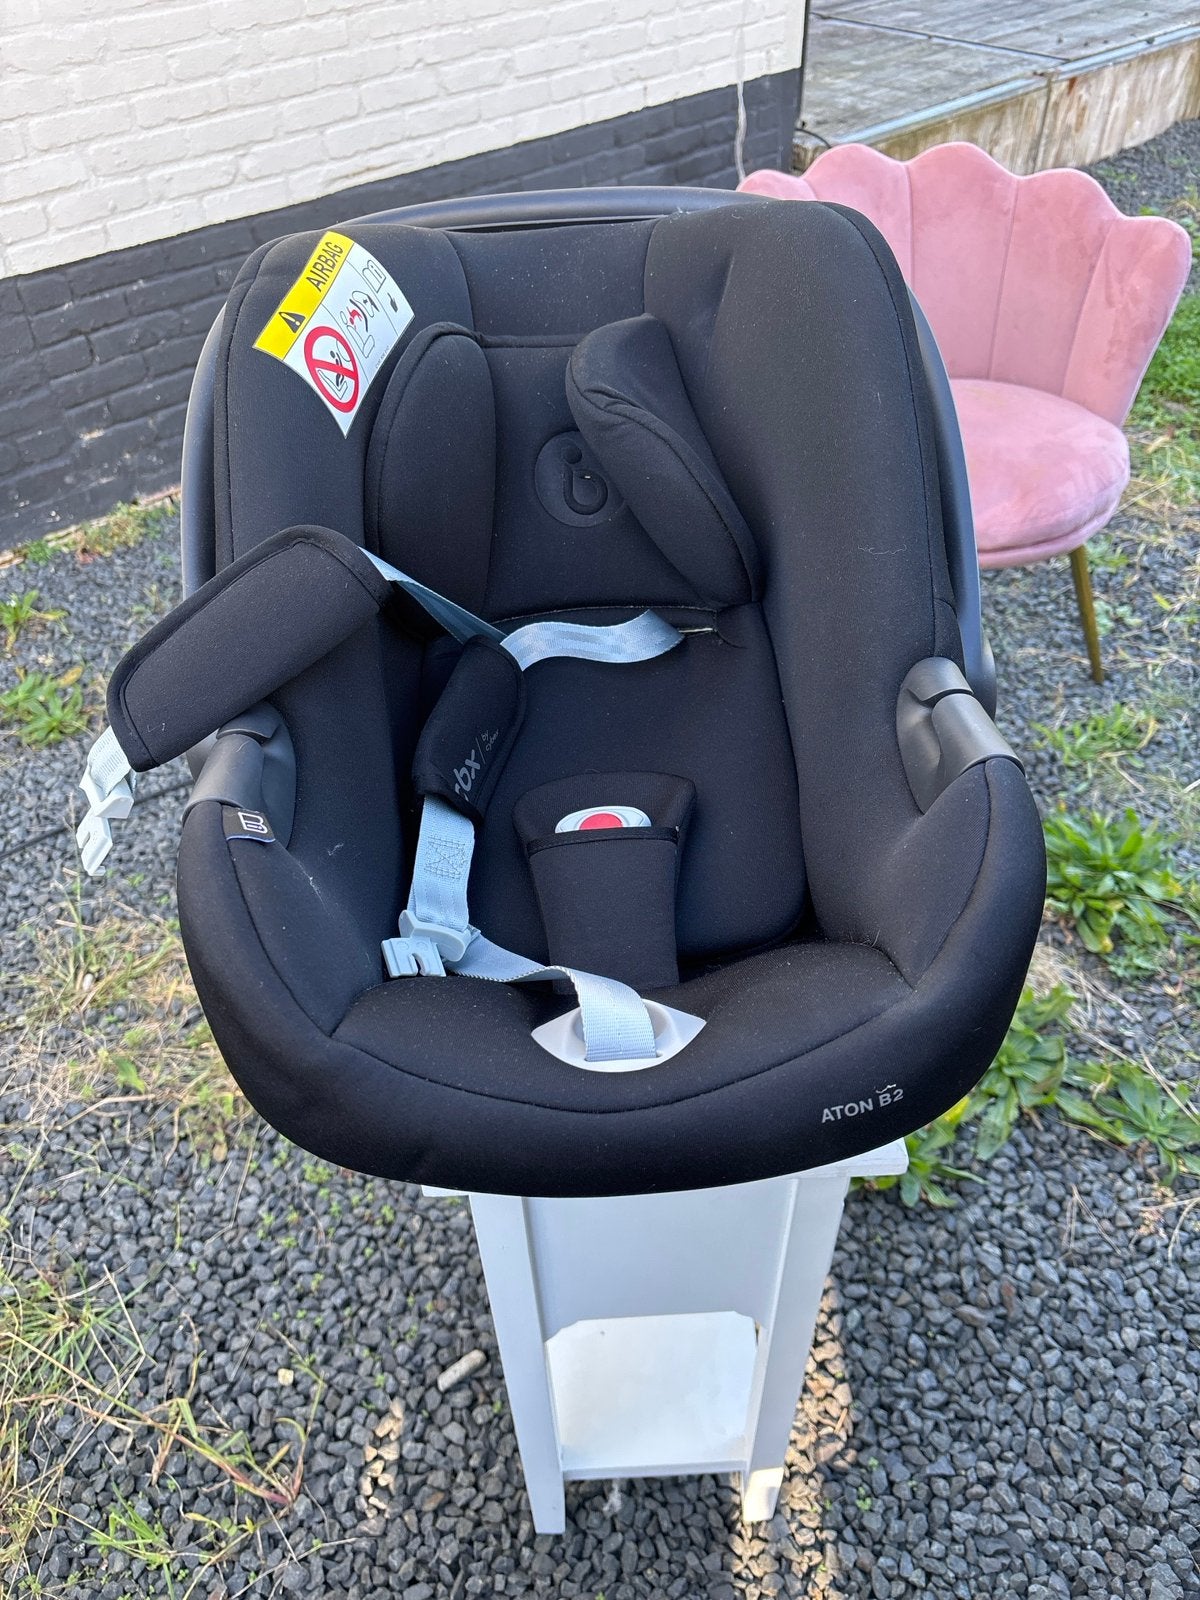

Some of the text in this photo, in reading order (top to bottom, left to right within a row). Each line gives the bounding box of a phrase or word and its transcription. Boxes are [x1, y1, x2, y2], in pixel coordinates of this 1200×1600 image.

[306, 241, 344, 292] AIRBAG
[821, 1088, 904, 1124] ATON B2
